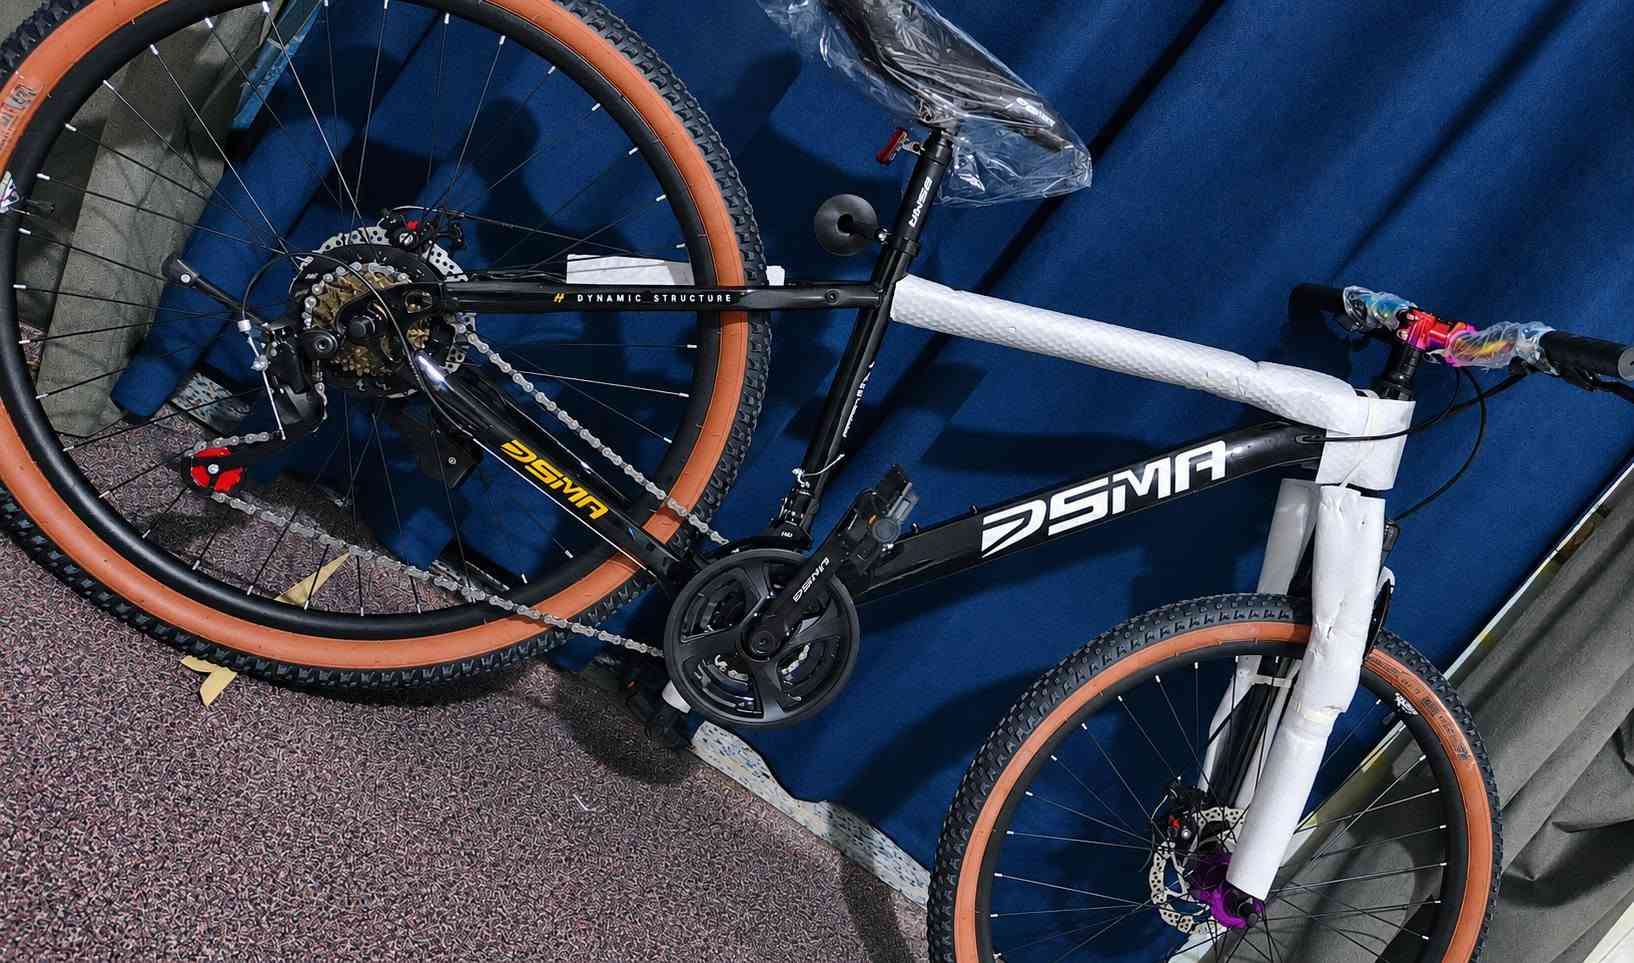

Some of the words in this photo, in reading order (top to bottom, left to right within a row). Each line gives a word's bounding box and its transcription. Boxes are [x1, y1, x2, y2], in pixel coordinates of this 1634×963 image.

[577, 294, 641, 303] DYNAMIC
[654, 294, 731, 303] STRUCTURE
[500, 440, 609, 519] DSMA
[981, 440, 1226, 558] DSMA
